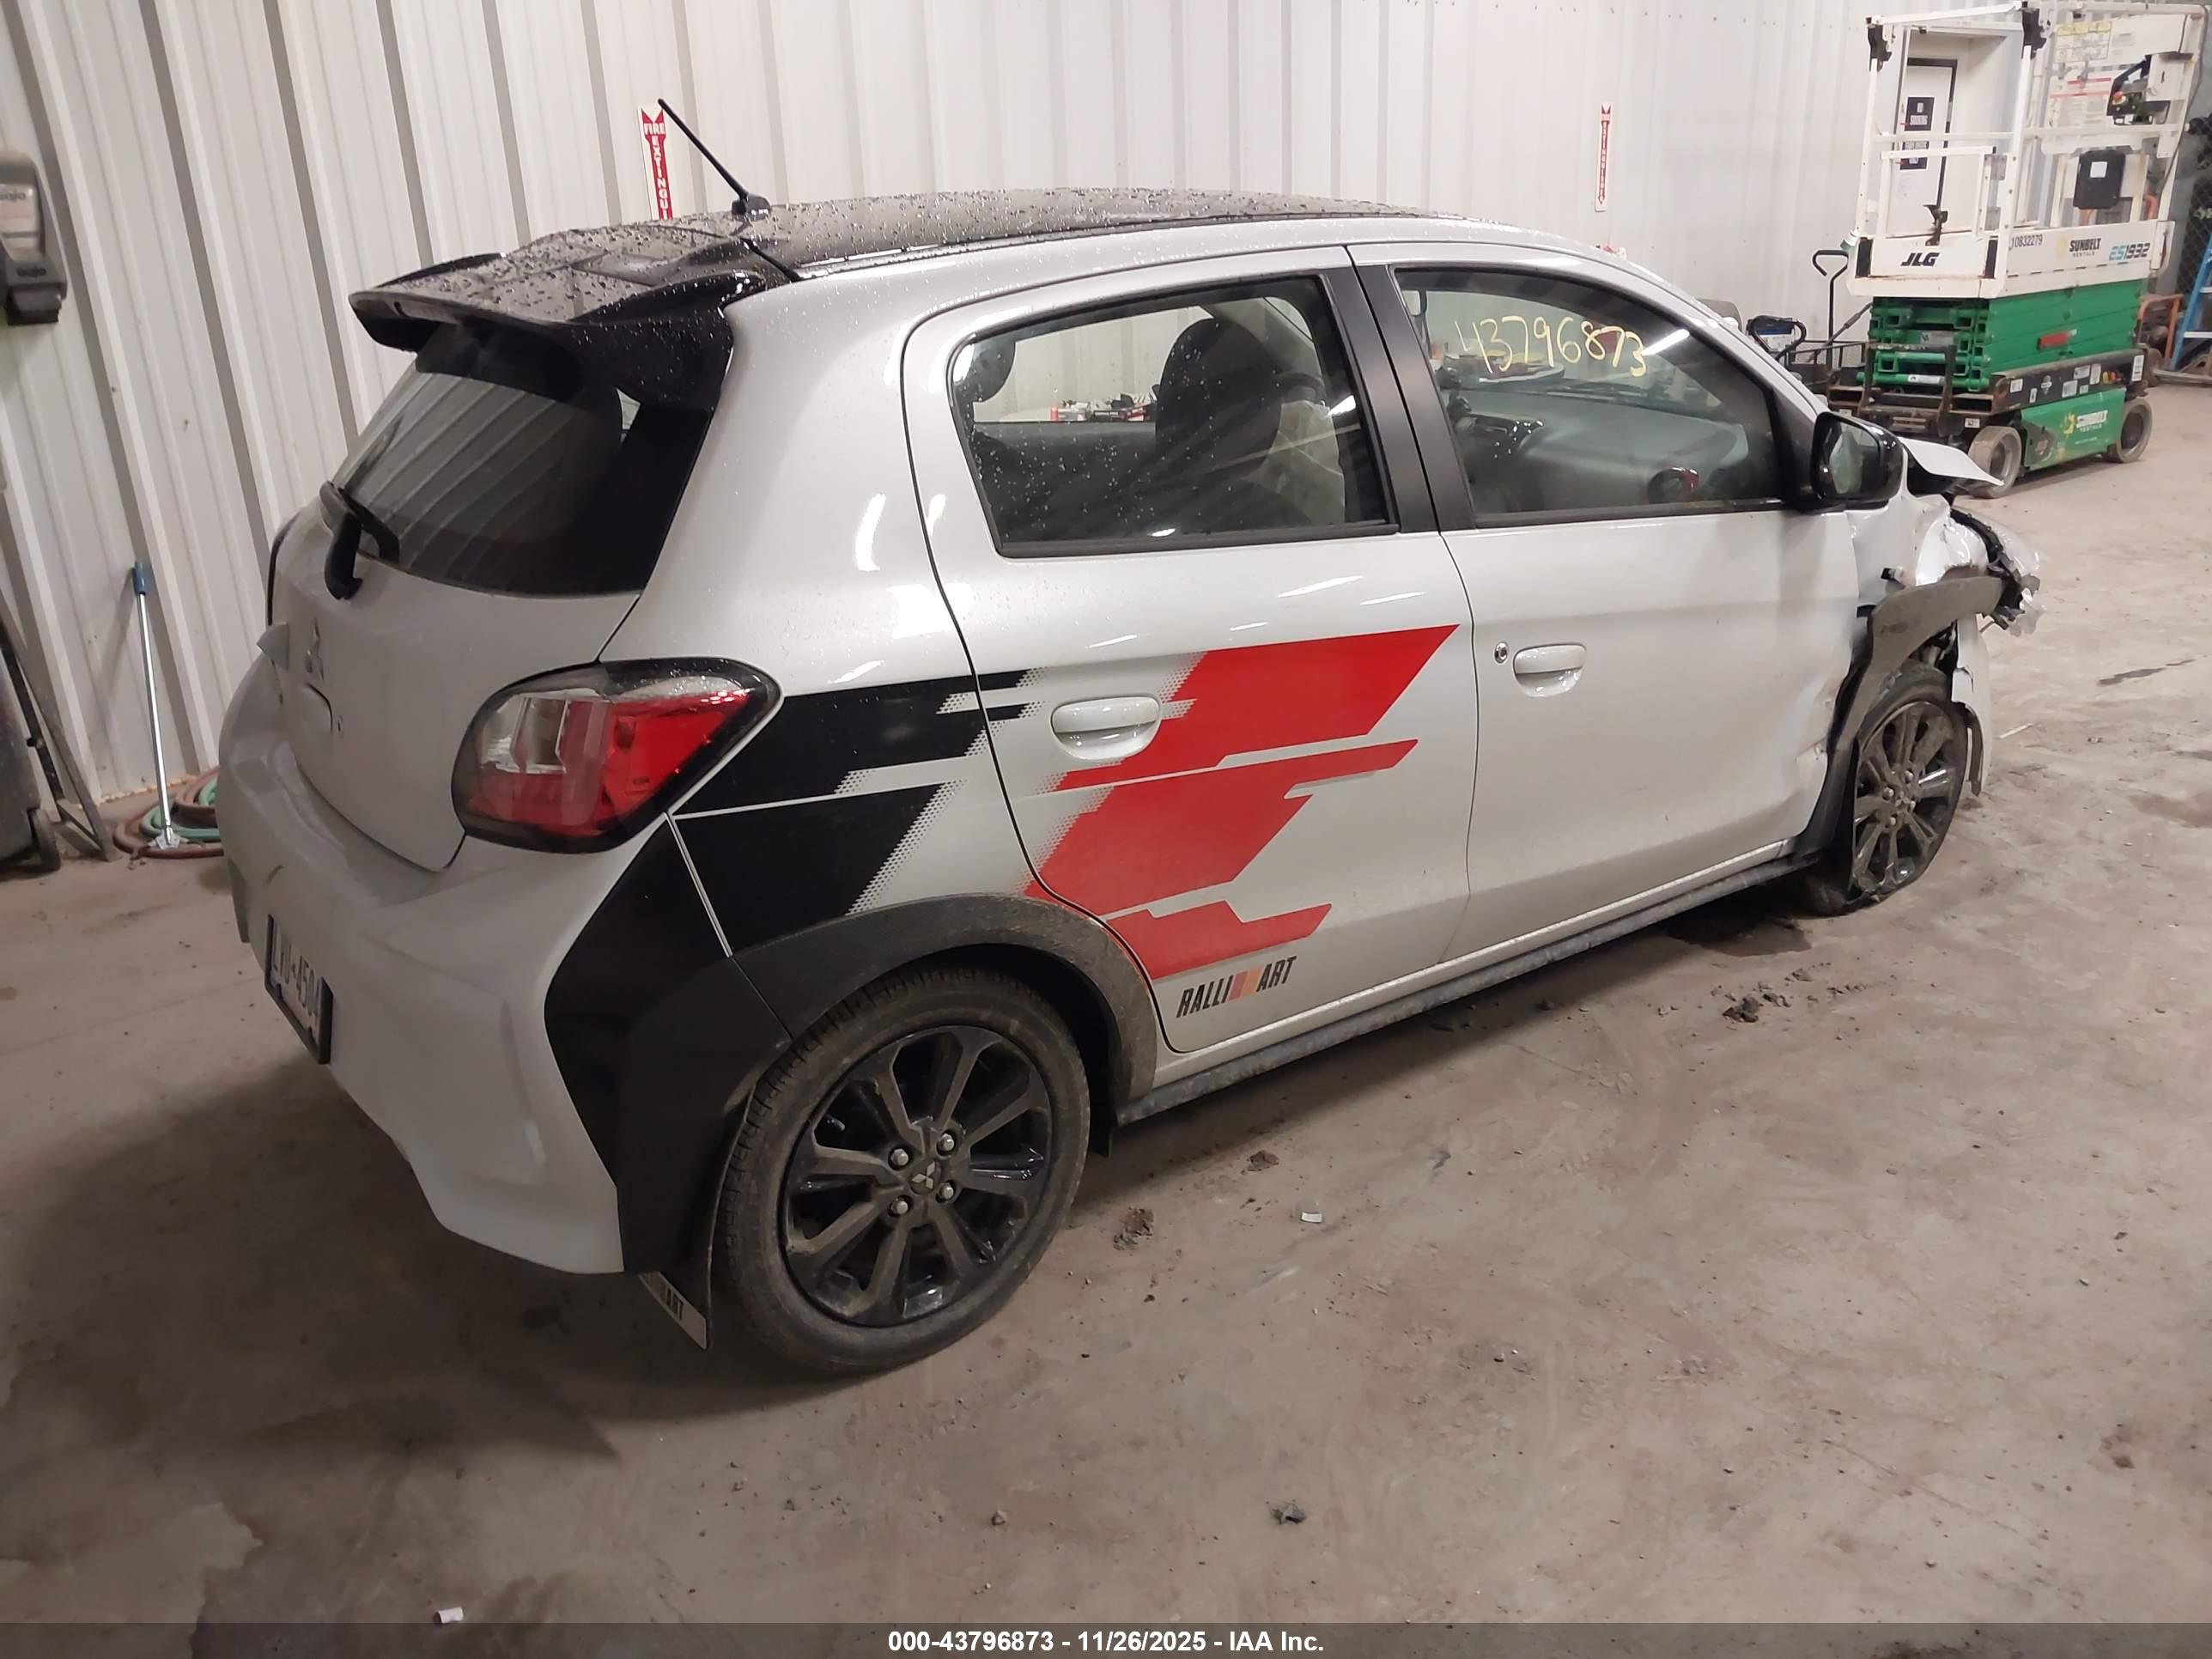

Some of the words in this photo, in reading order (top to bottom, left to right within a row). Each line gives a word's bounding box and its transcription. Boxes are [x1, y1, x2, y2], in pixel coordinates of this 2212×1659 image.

[643, 123, 665, 135] FIRE
[1900, 252, 1941, 267] JLG
[2108, 243, 2151, 261] ES1932
[1454, 315, 1648, 378] 43796873
